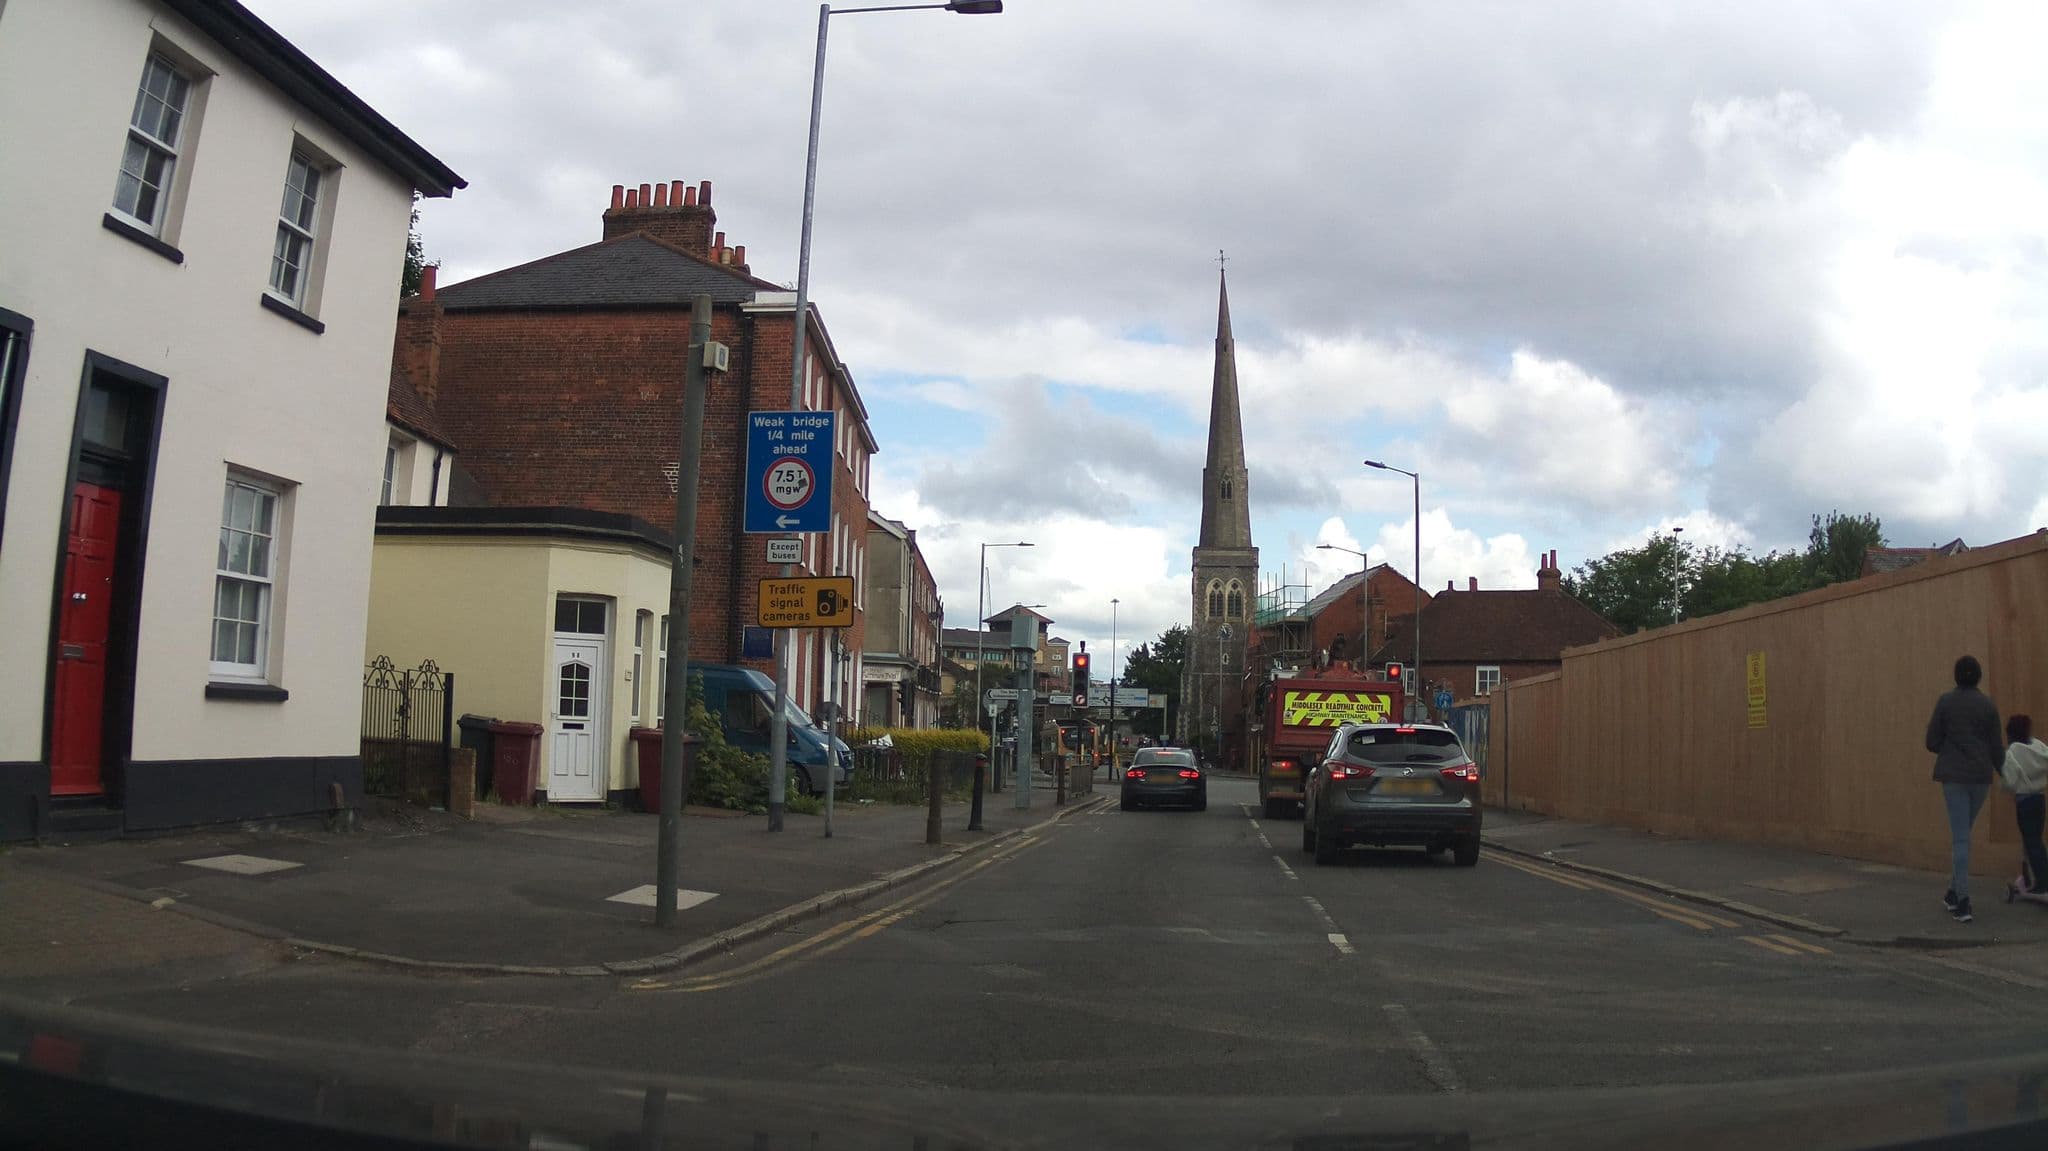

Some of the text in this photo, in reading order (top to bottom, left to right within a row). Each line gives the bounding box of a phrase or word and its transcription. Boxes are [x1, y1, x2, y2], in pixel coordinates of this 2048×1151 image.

[754, 416, 830, 428] Weak bridge
[767, 430, 815, 441] 1/4 mile
[773, 443, 807, 454] ahead
[770, 542, 799, 552] Except
[772, 552, 797, 560] buses
[768, 584, 806, 595] Traffic
[769, 597, 804, 609] signal
[762, 612, 811, 621] cameras
[1292, 701, 1384, 712] MIDDLESEX READYMIX CONCRETE
